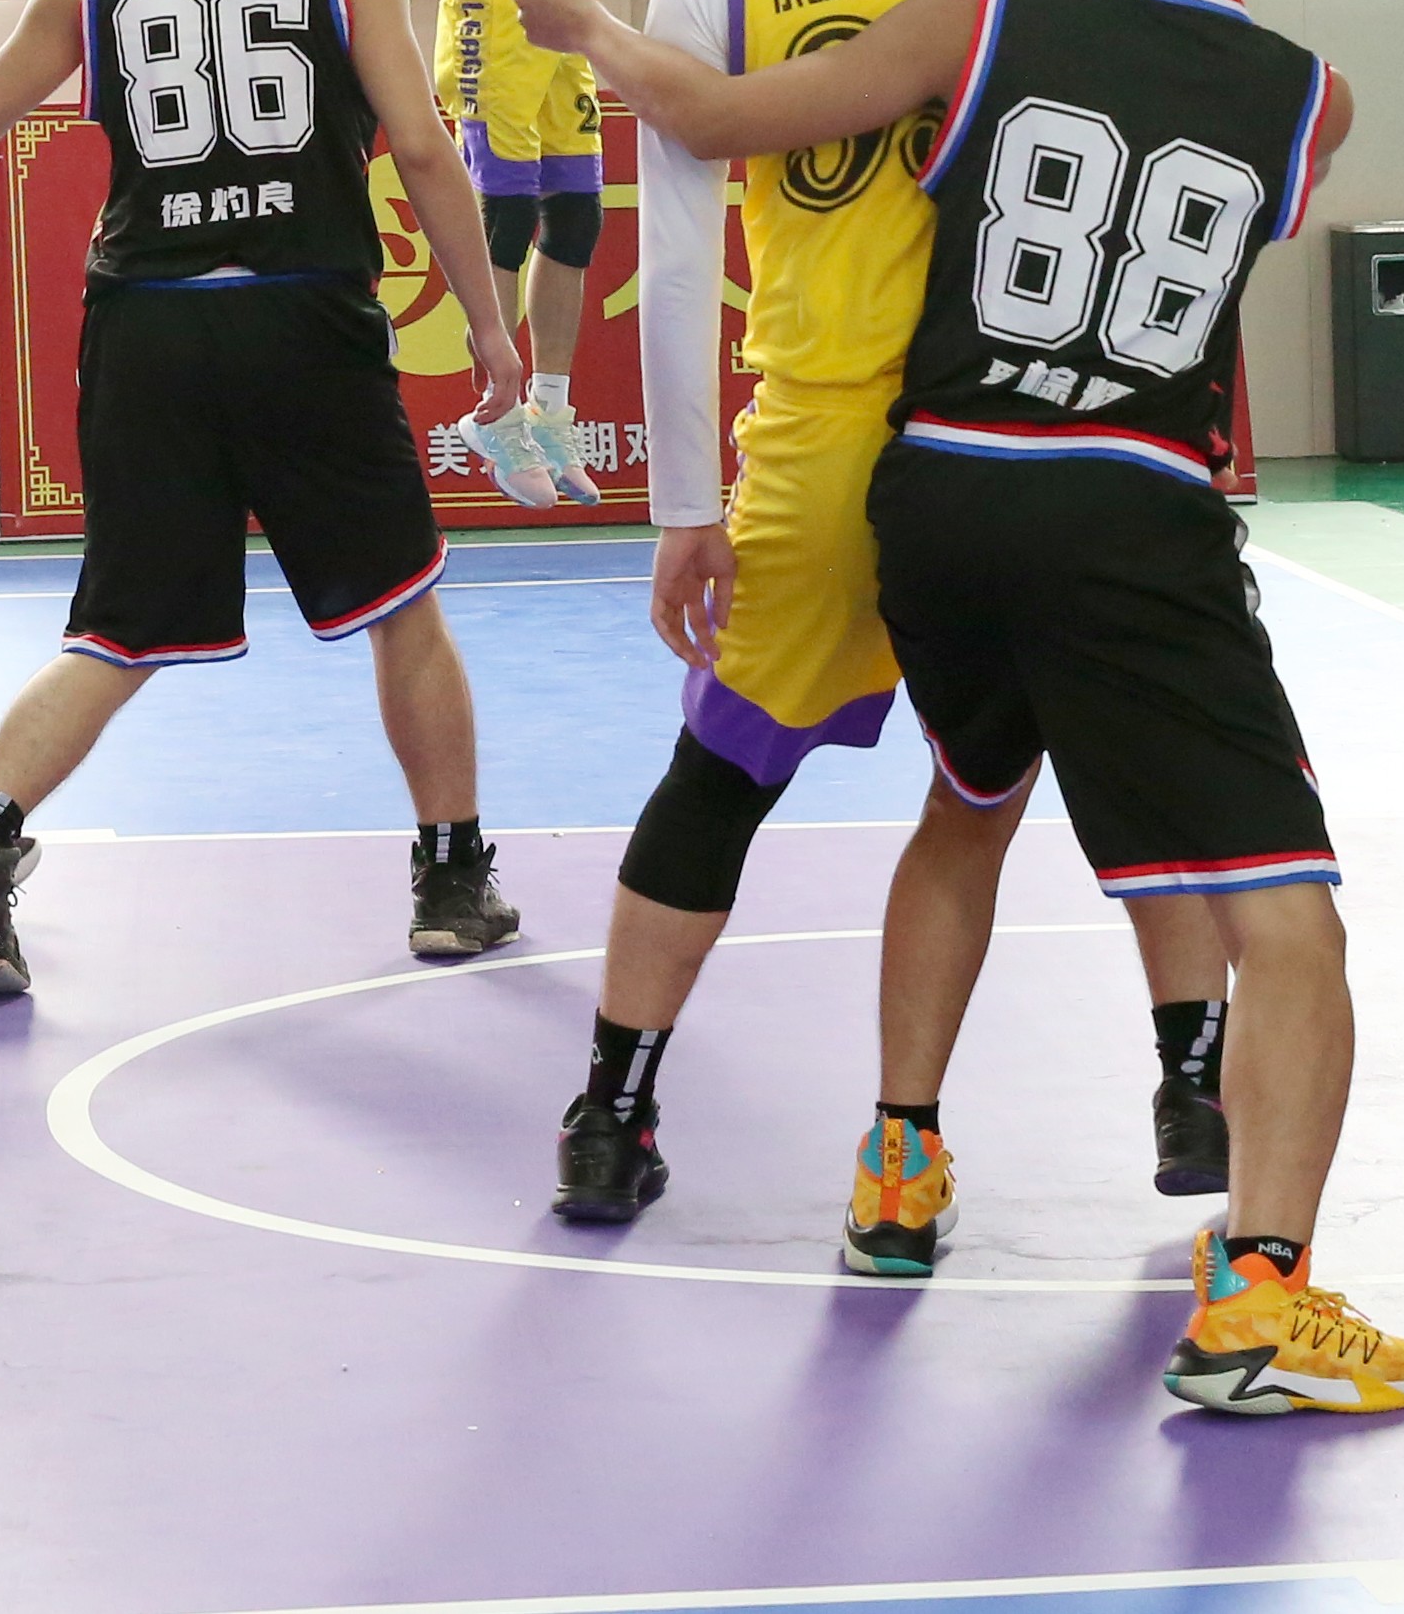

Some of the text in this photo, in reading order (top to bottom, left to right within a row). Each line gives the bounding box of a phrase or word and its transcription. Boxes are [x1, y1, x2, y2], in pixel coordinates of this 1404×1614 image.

[160, 180, 296, 229] 徐灼良
[972, 96, 1265, 377] 88
[1257, 1242, 1293, 1260] NBA
